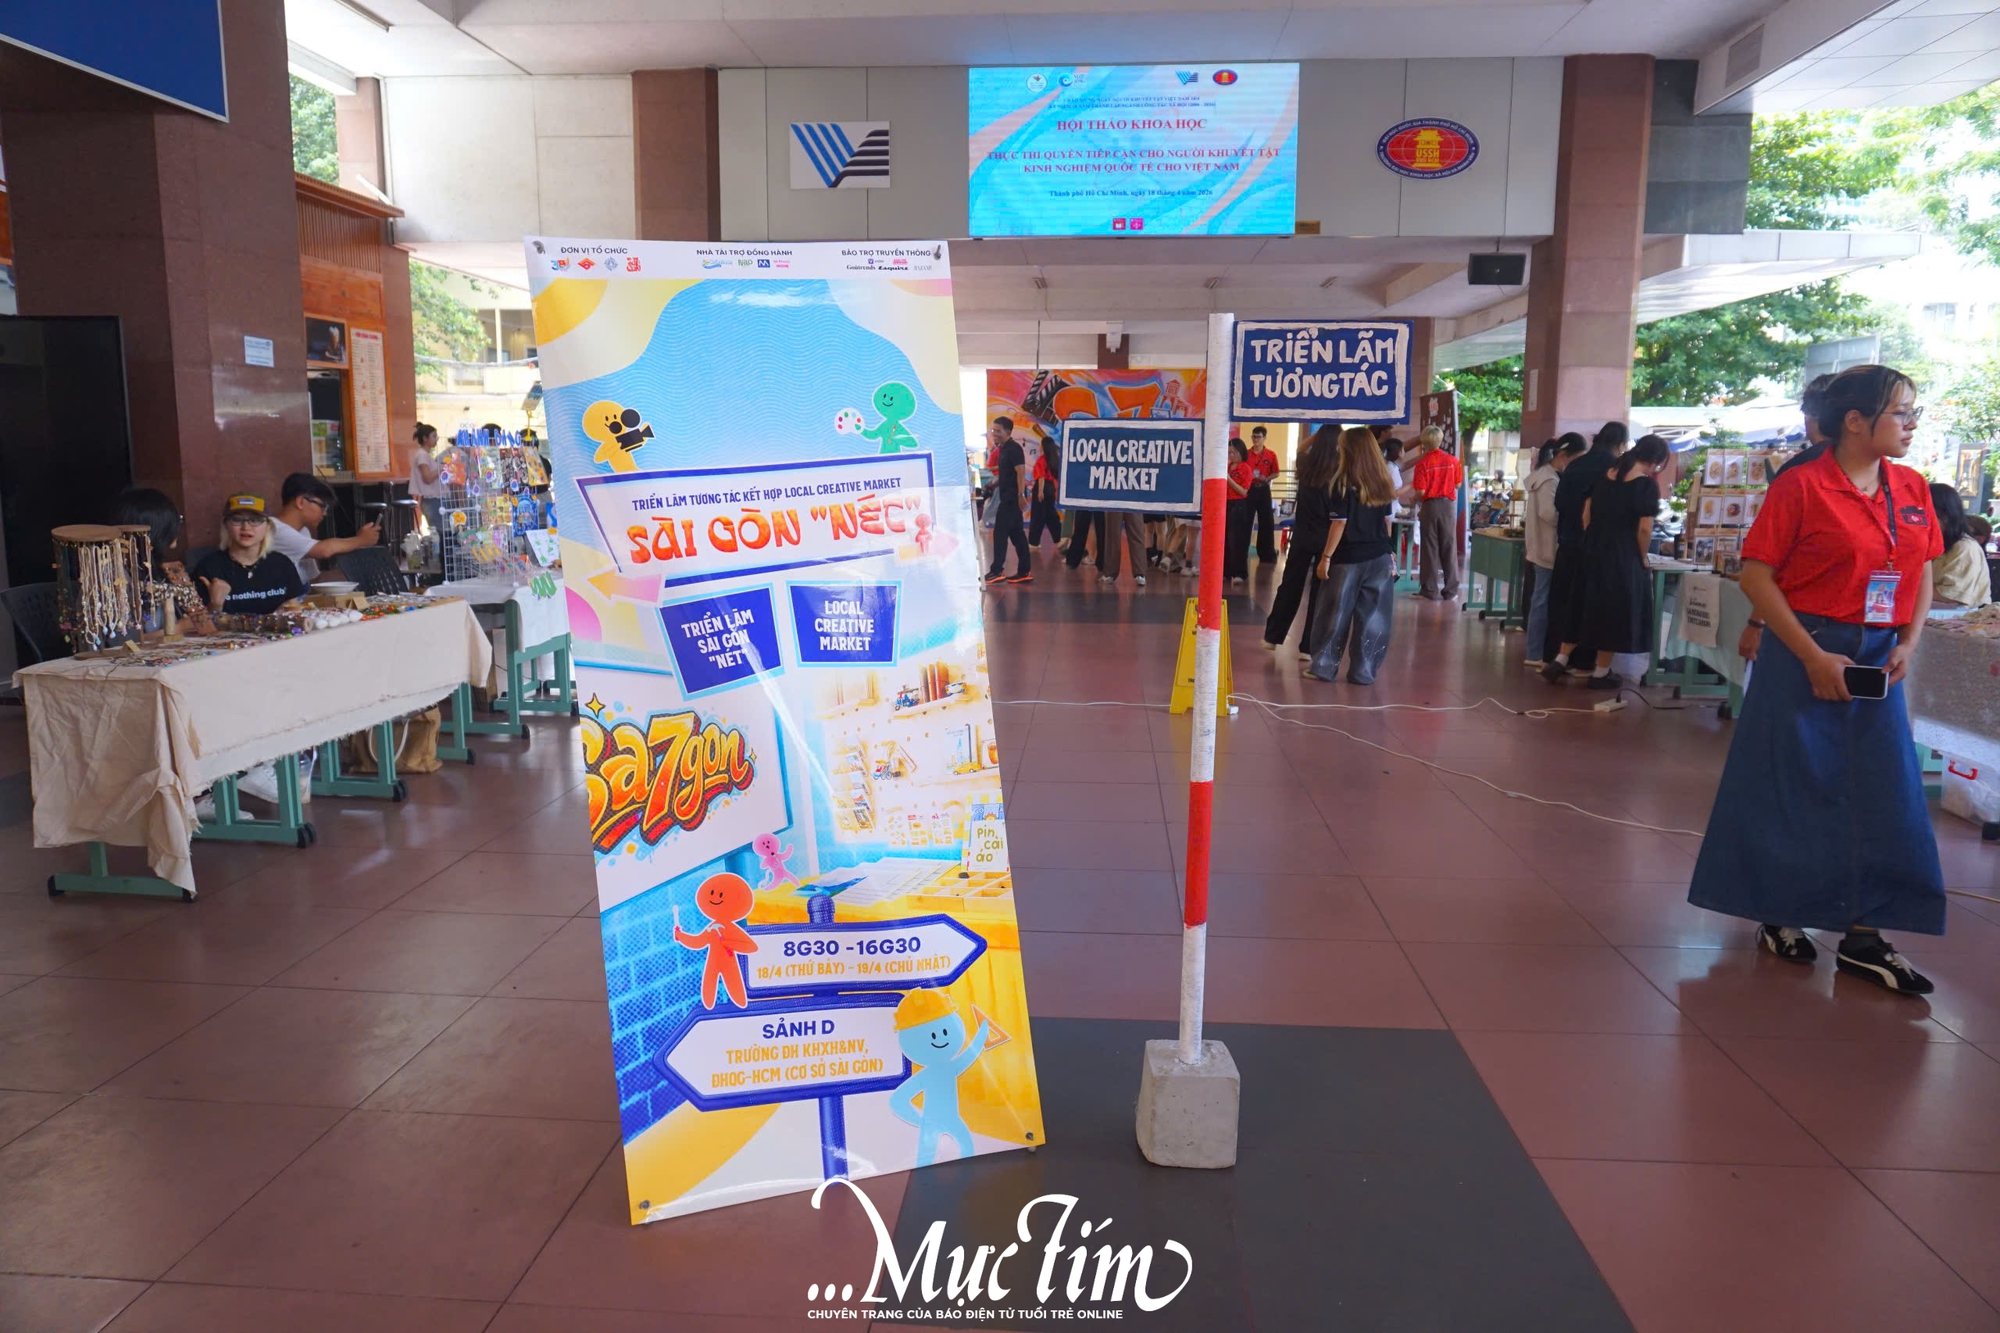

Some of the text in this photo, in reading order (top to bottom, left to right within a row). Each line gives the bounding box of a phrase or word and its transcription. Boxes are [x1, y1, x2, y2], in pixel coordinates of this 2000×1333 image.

[1057, 117, 1207, 132] HỘI THẢO KHOA HỌC
[988, 146, 1280, 160] THỰC THI QUYỀN TIẾP CẬN CHO NGƯỜI KHUYẾT TẬT
[1416, 149, 1440, 158] USSH
[1024, 161, 1240, 174] KINH NGHIỆM QUỐC TẾ CHO VIỆT NAM
[561, 244, 628, 256] ĐƠN VỊ TỔ CHỨC
[696, 248, 792, 257] NHÀ TÀI TRỢ ĐỒNG HÀNH
[859, 250, 874, 258] TRỢ
[876, 248, 904, 256] TRUYỀN
[906, 248, 931, 256] THÔNG
[1339, 330, 1394, 364] LÃM
[1068, 438, 1192, 466] LOCAL CREATIVE
[1088, 466, 1160, 492] MARKET
[632, 477, 902, 511] TRIỂN LÃM TƯƠNG TÁC KẾT HỢP LOCAL CREATIVE MARKET
[626, 516, 698, 564] SÀI
[708, 508, 802, 553] GÒN
[232, 590, 266, 600] nothing
[824, 600, 864, 616] LOCAL
[681, 608, 755, 639] TRIỂN LÃM
[814, 618, 875, 633] CREATIVE
[698, 626, 750, 654] SÀI GÒN
[820, 636, 872, 651] MARKET
[784, 940, 840, 957] 8G30
[757, 964, 782, 980] 18/4
[785, 958, 814, 978] (THỨ
[818, 958, 845, 976] BẢY)
[857, 962, 882, 974] 19/4
[885, 955, 913, 974] (CHỦ
[917, 954, 951, 972] NHẬT)
[762, 1017, 835, 1040] SẢNH D
[726, 1038, 869, 1065] TRƯỜNG ĐH KHXH&NV,
[712, 1055, 883, 1088] ĐHQG-HCM (CƠ SỞ SÀI GÒN)
